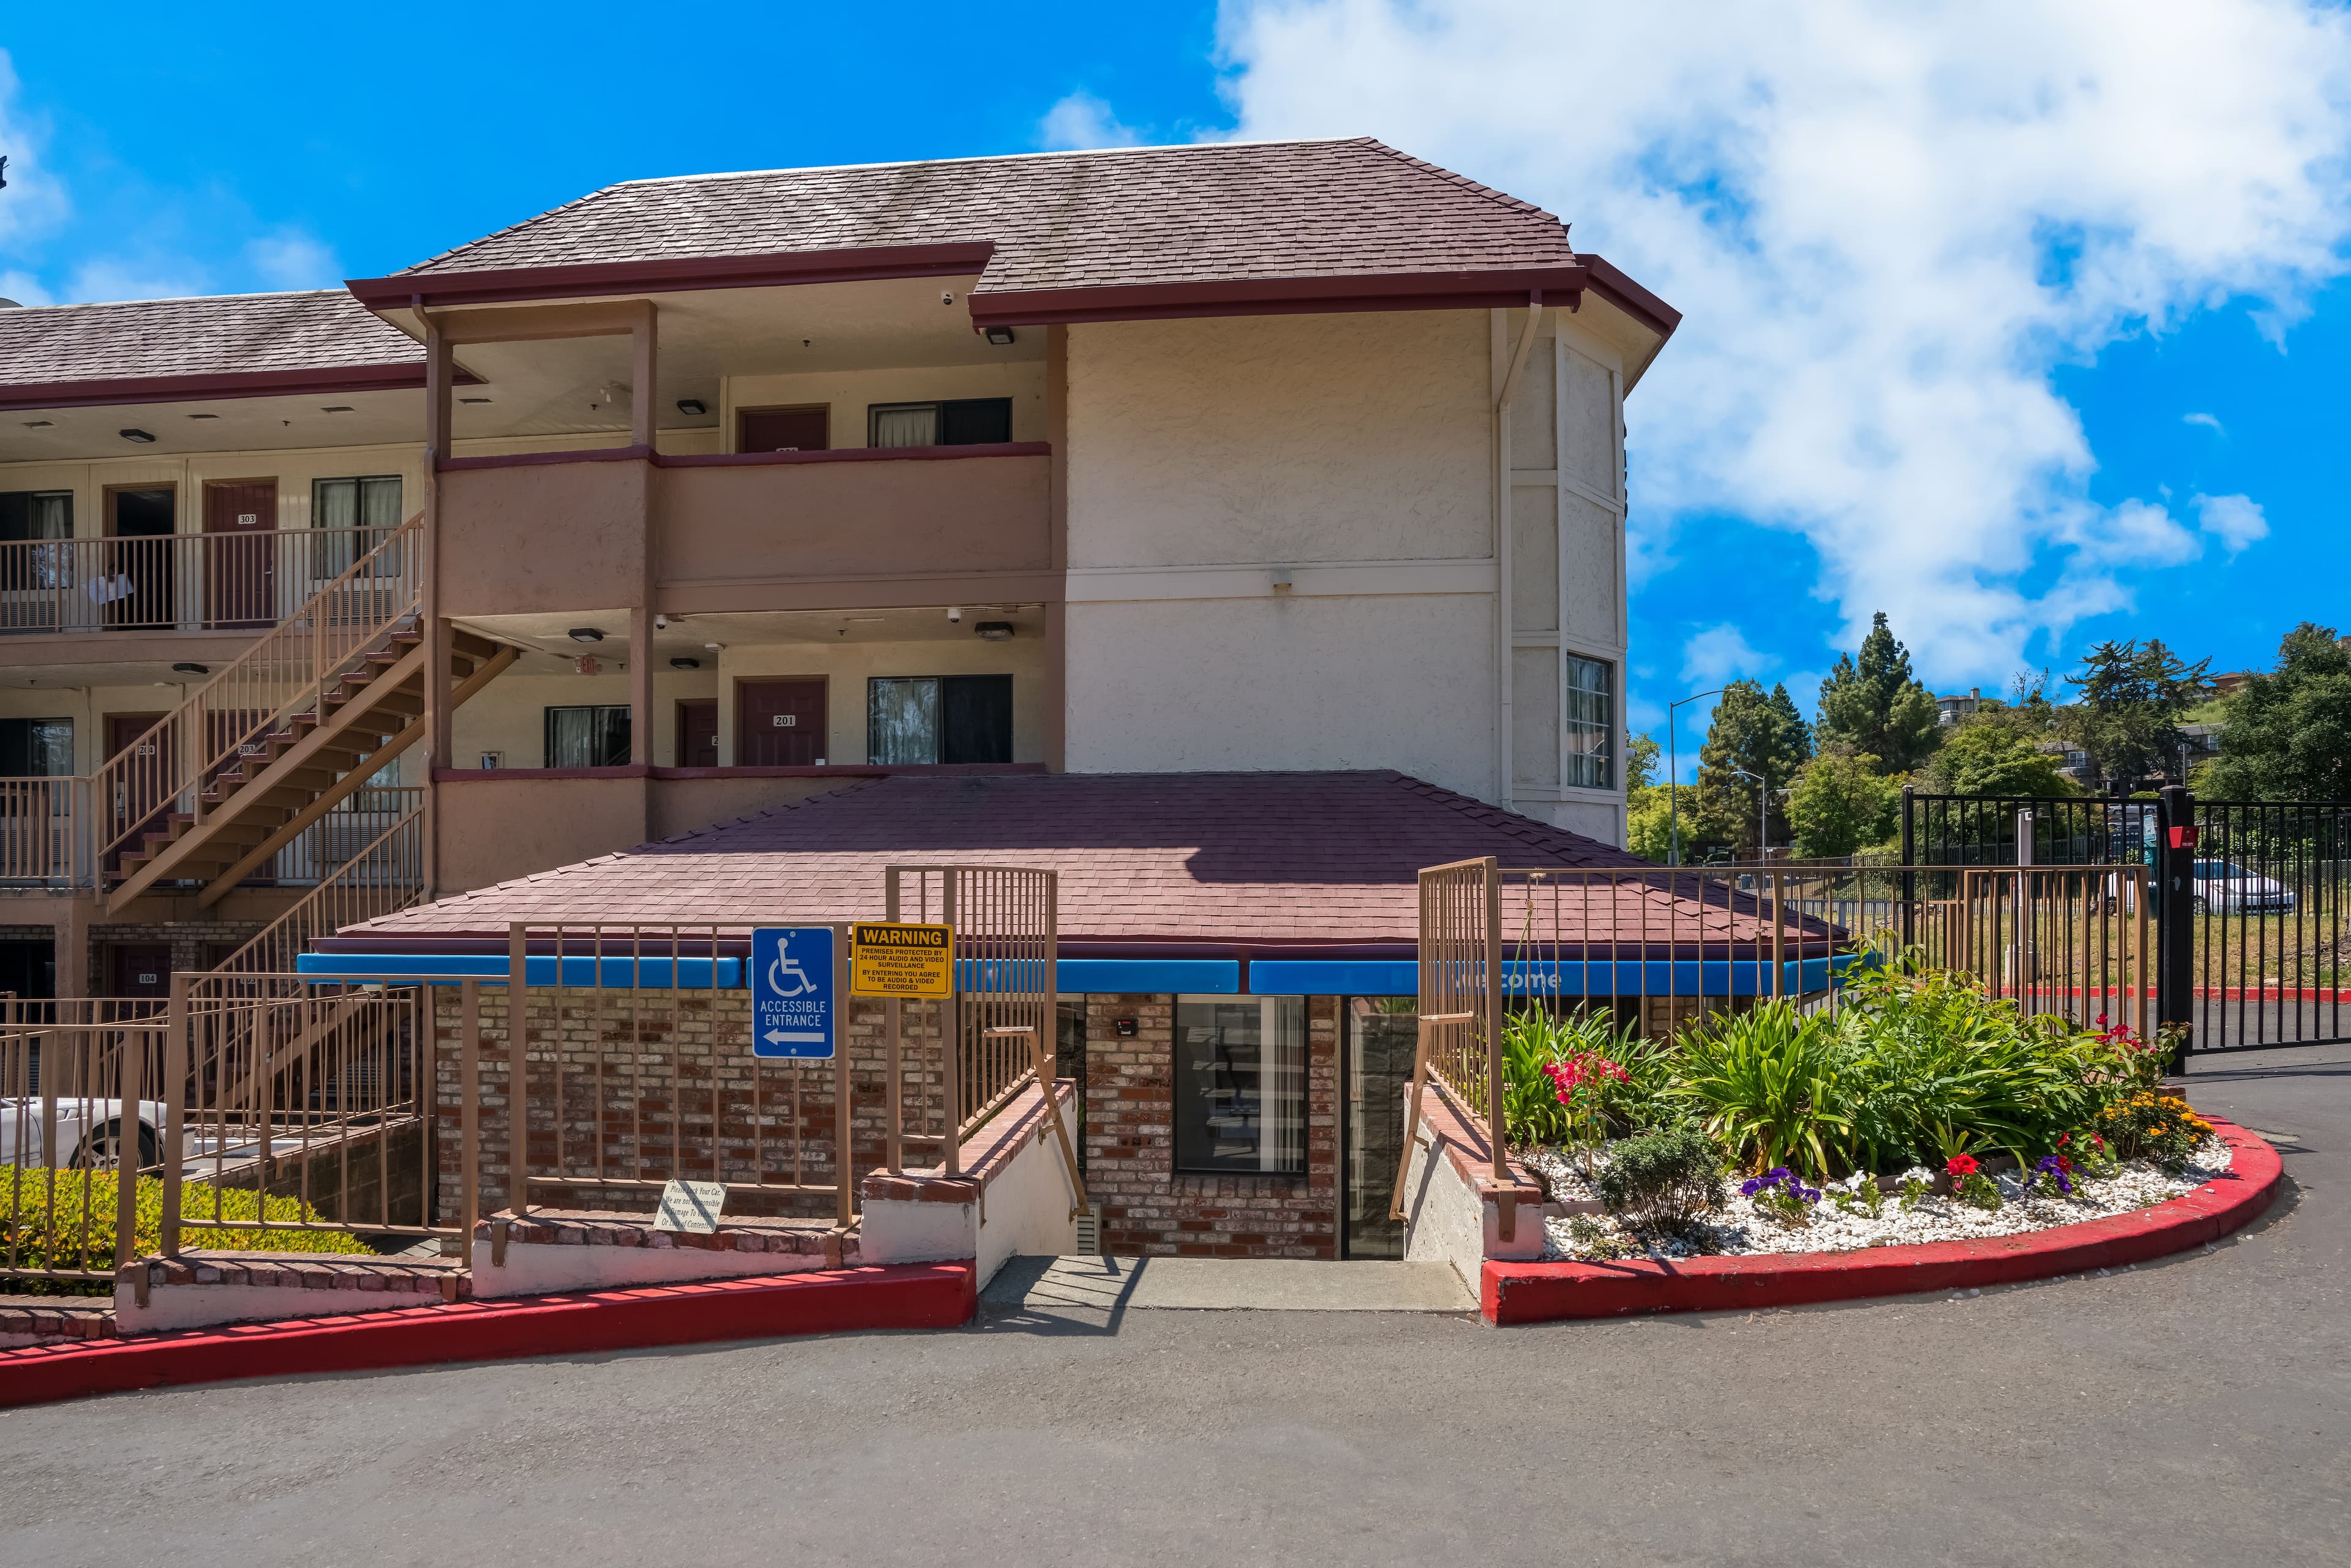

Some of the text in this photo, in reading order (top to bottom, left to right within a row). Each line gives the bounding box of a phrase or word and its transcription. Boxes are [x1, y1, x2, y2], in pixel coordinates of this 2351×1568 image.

[582, 656, 595, 674] EXIT
[776, 716, 793, 725] 201
[863, 929, 942, 945] WARNING
[760, 1000, 827, 1013] ACCESSIBLE
[765, 1014, 822, 1027] ENTRANCE
[691, 1199, 720, 1207] Responsible
[670, 1207, 689, 1218] Damage
[698, 1210, 718, 1218] Vehicles
[669, 1218, 681, 1227] Loss
[687, 1220, 710, 1229] Contents.
